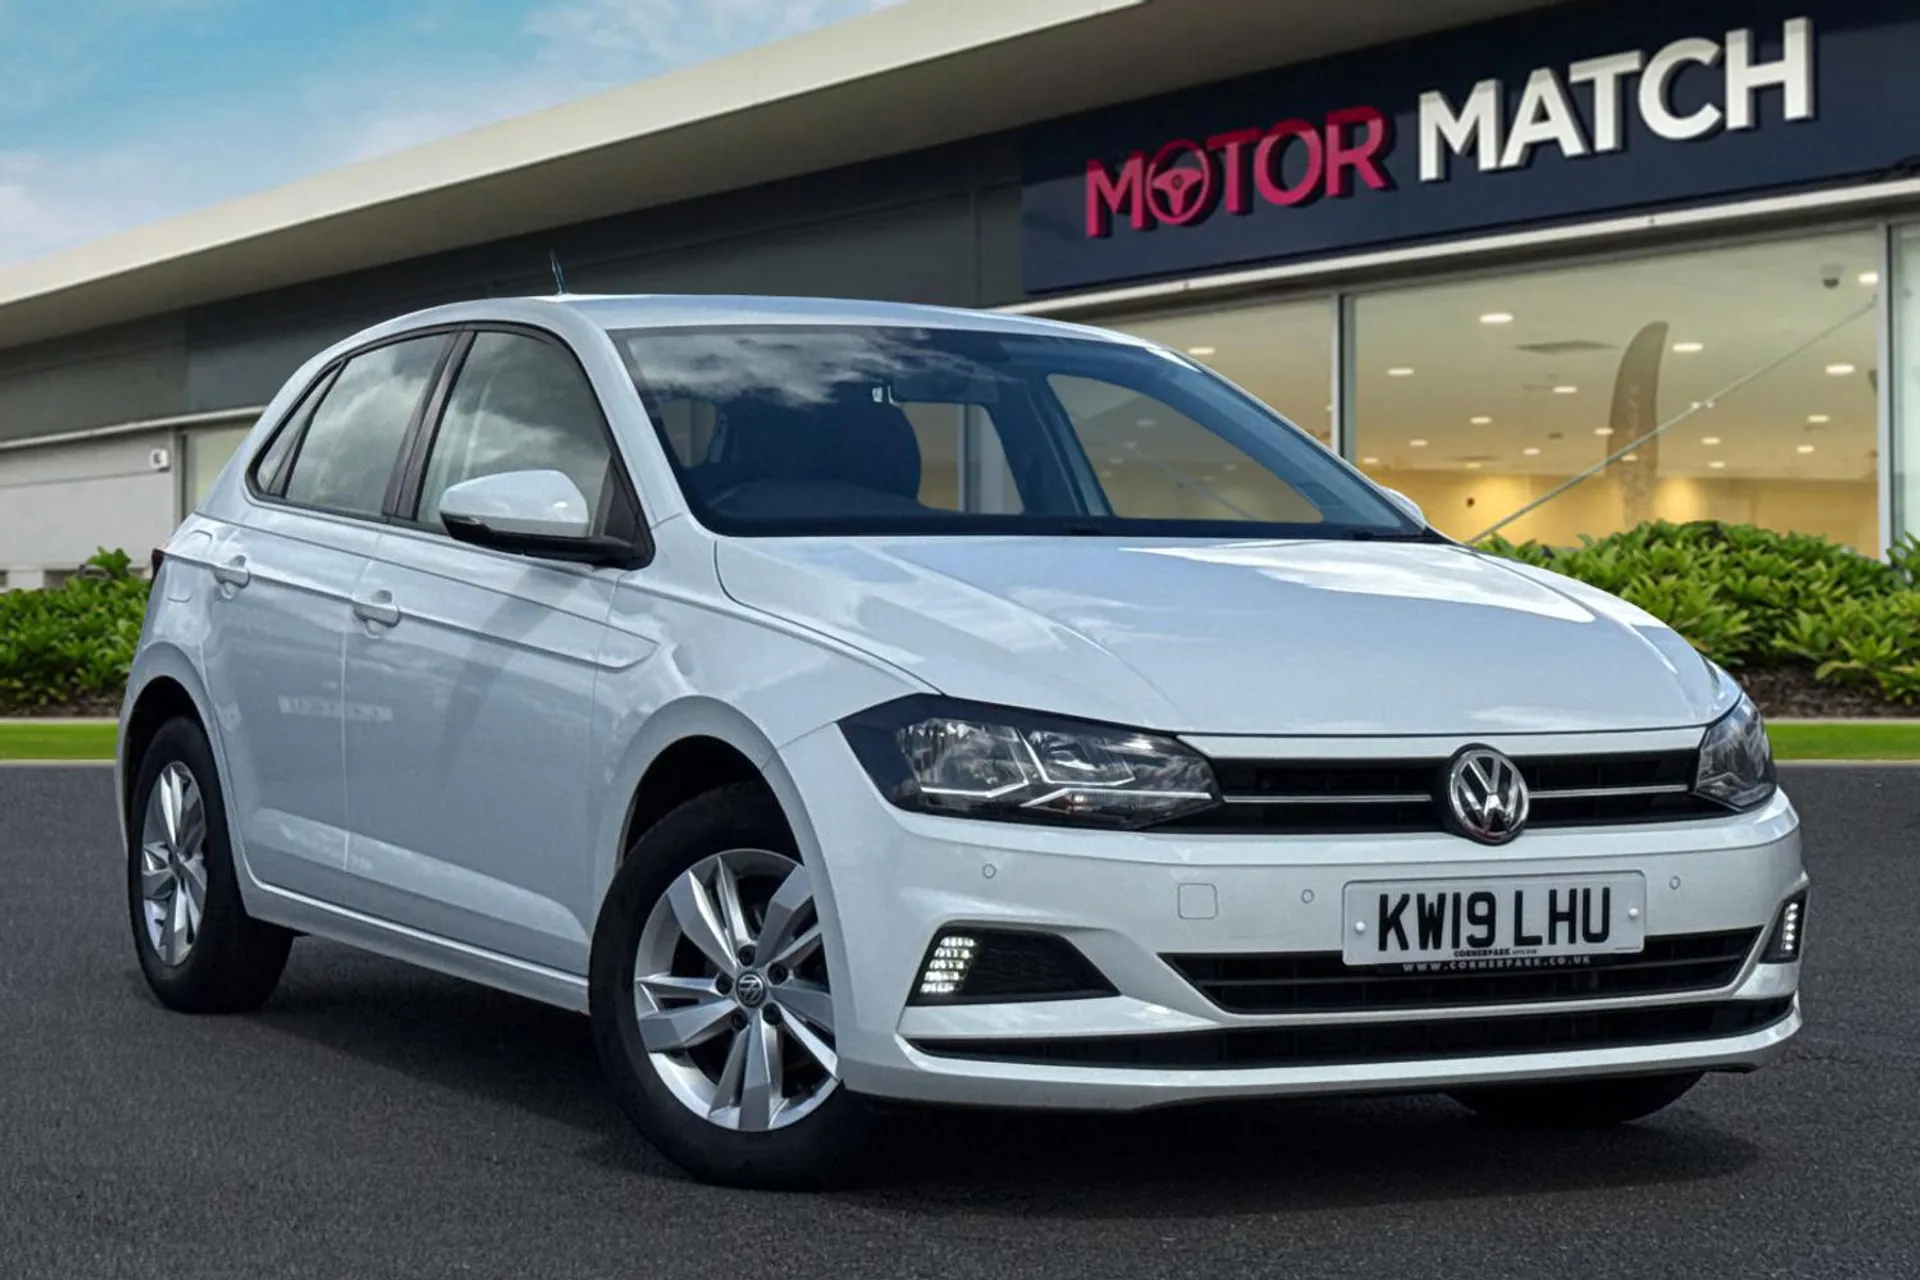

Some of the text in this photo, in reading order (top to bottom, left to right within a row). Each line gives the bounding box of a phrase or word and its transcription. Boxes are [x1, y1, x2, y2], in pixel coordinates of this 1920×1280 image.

[1085, 17, 1815, 238] MOTOR MATCH
[1378, 888, 1610, 951] KW19 LHU
